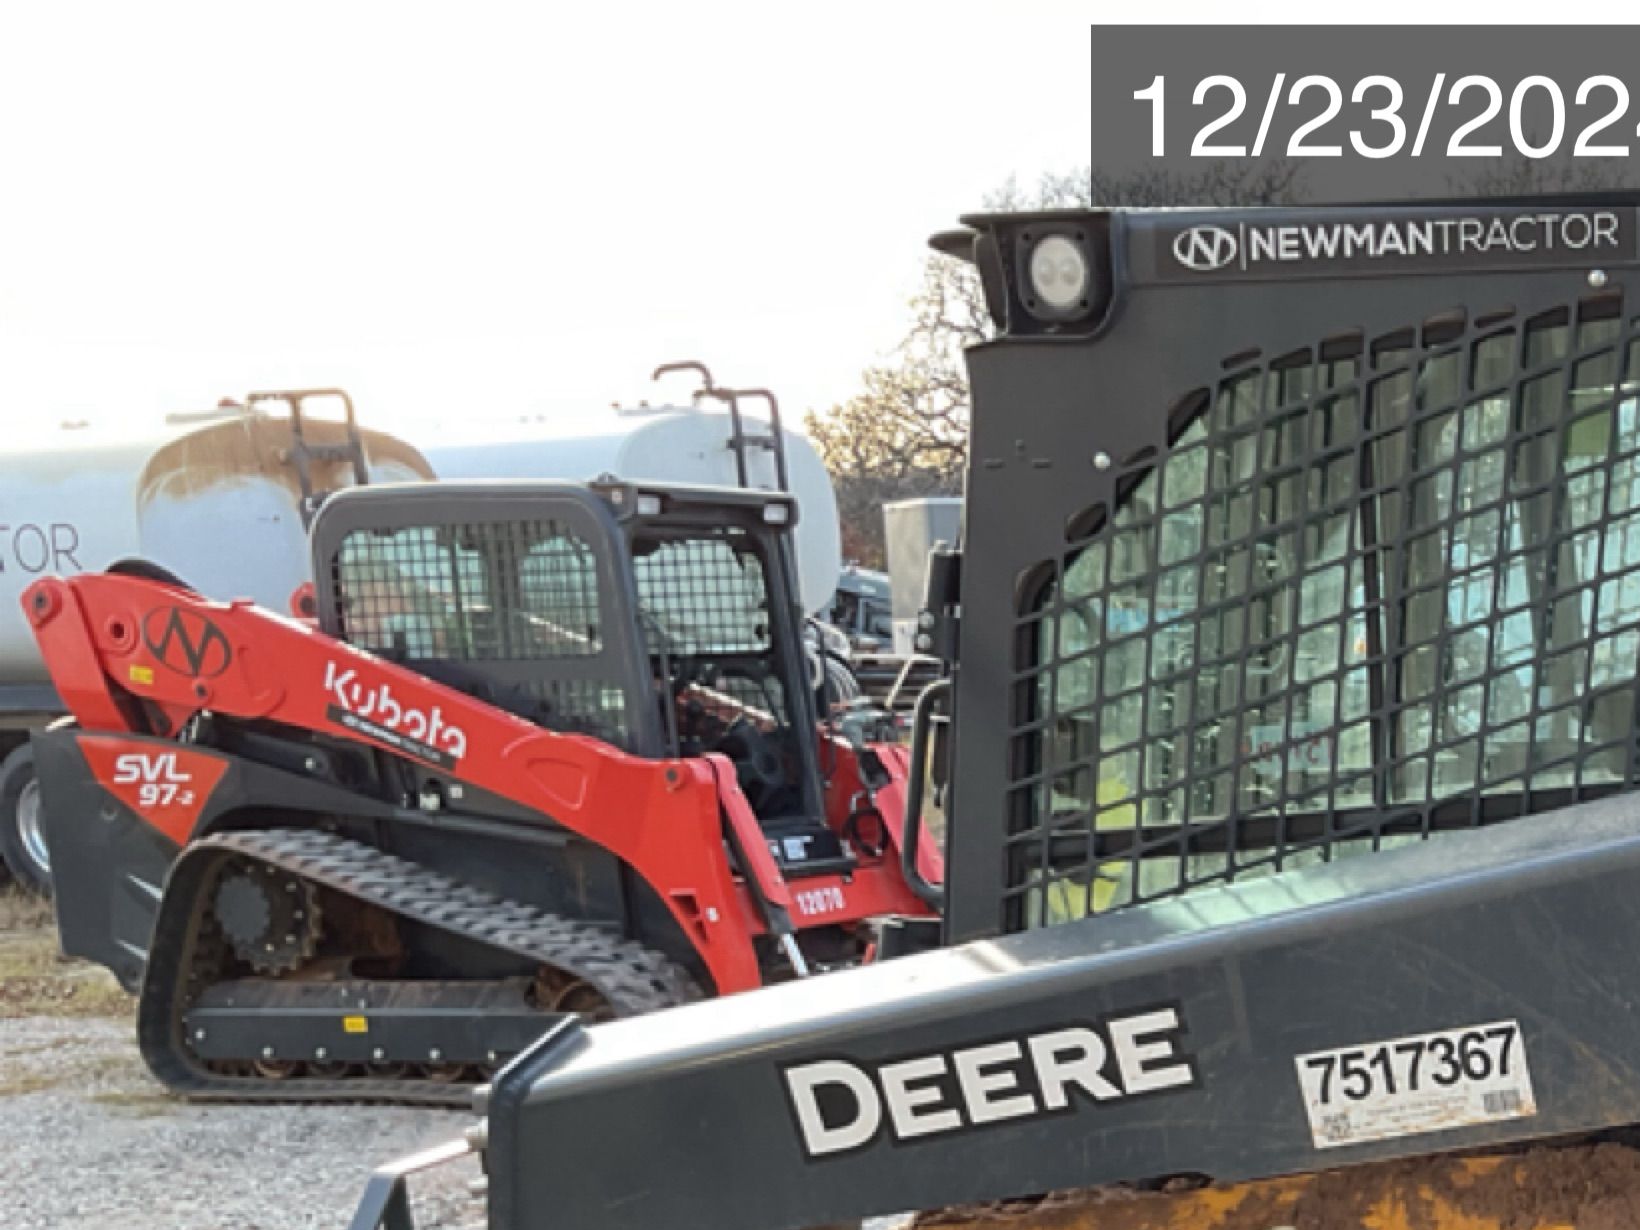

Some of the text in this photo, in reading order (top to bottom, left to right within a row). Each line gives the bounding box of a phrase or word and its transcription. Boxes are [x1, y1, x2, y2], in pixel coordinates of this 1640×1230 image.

[324, 660, 467, 760] Kubota
[114, 753, 192, 783] SVL
[784, 1006, 1193, 1157] DEERE
[1305, 1026, 1517, 1105] 7517367
